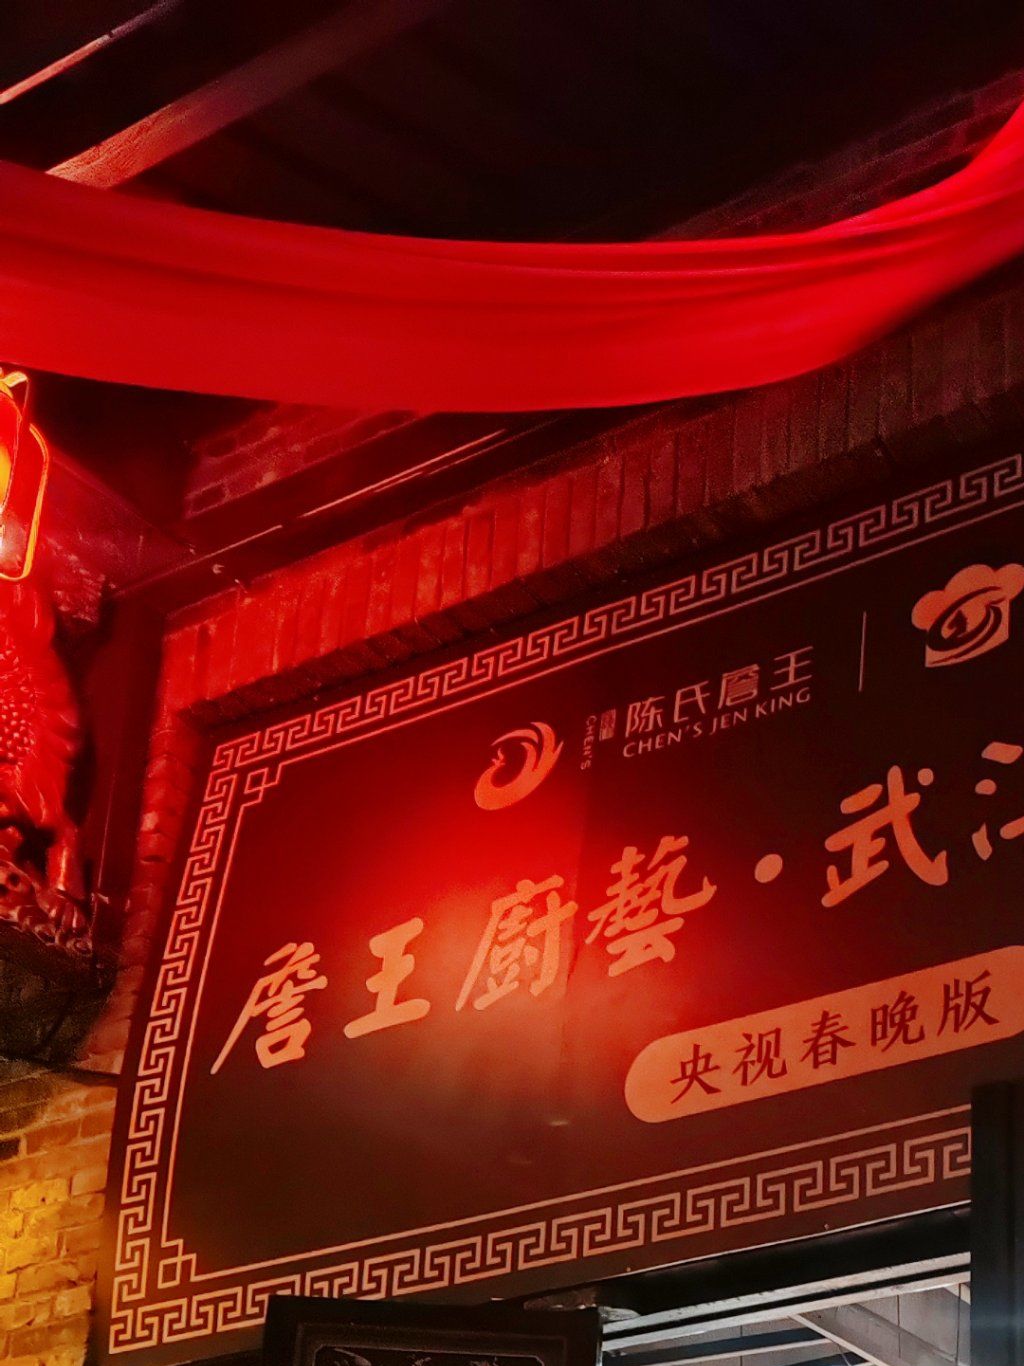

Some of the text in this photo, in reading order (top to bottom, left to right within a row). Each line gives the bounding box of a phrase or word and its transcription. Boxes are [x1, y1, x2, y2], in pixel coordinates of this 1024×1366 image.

[622, 721, 704, 758] CHEN'S
[709, 707, 748, 736] JEN
[754, 687, 812, 719] KING
[671, 970, 1001, 1105] 央视春晚版
